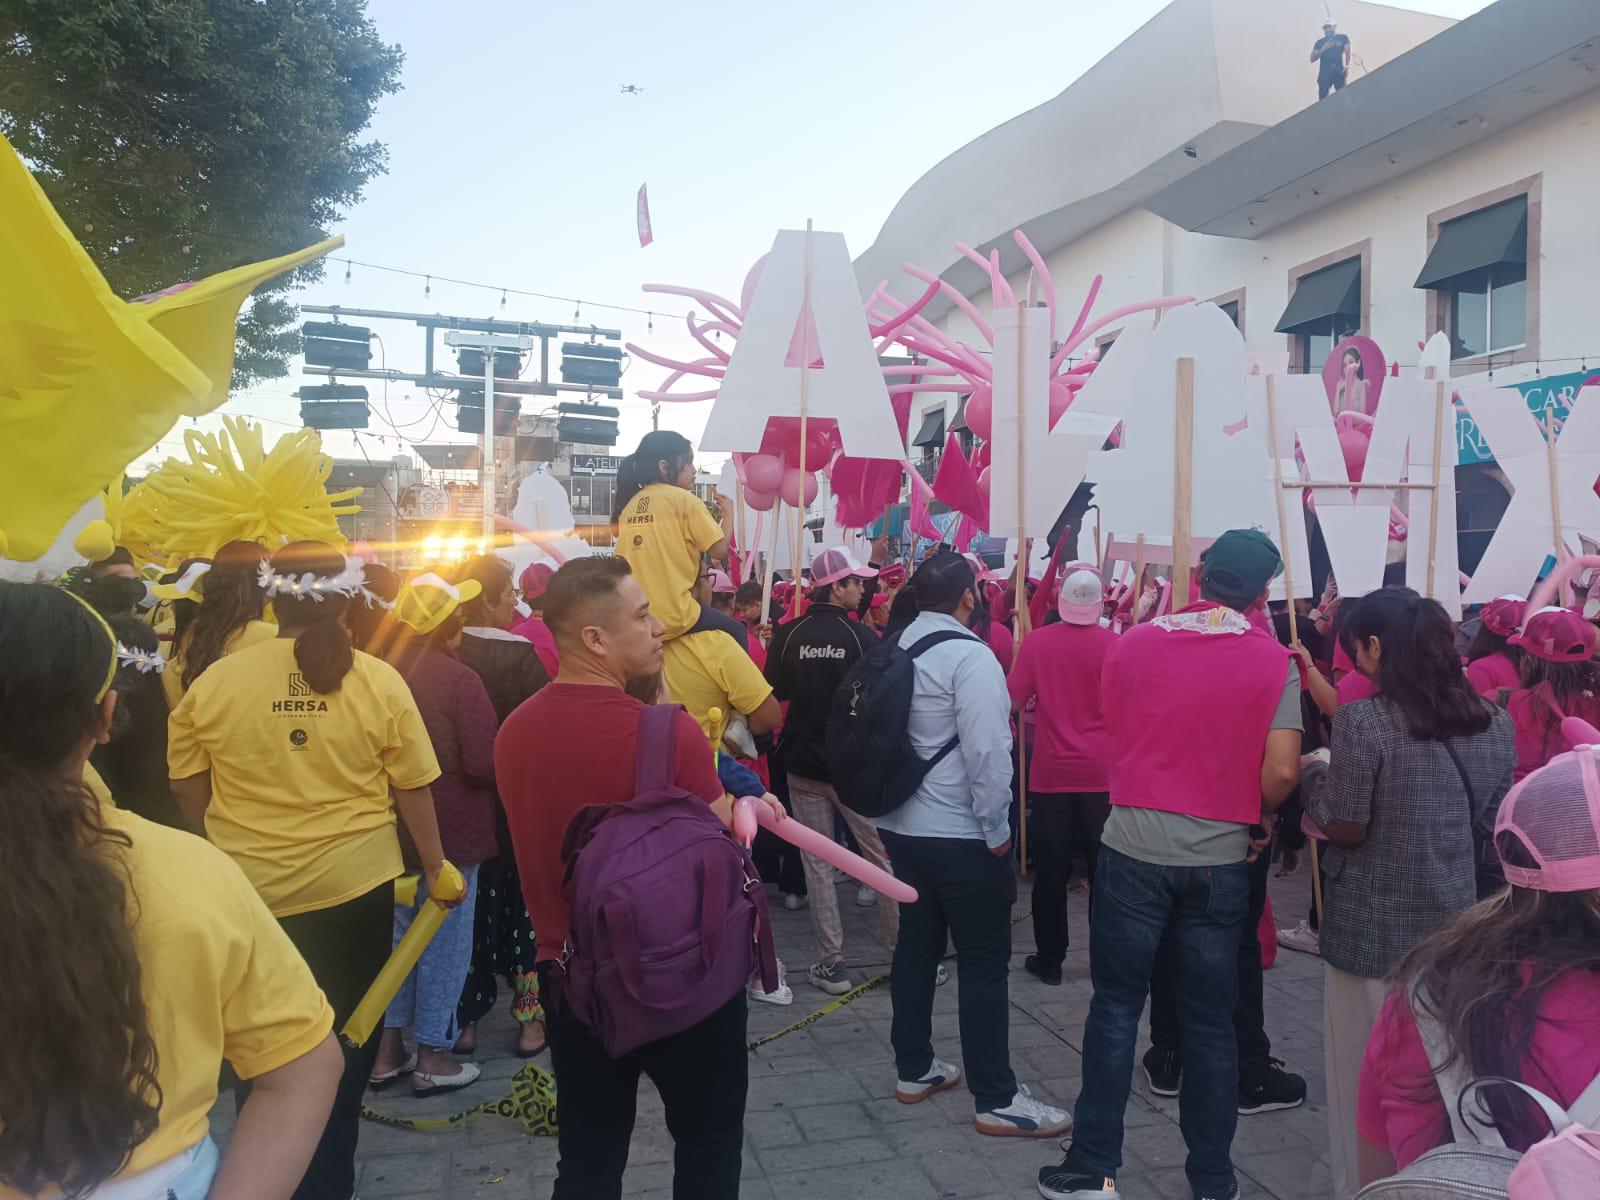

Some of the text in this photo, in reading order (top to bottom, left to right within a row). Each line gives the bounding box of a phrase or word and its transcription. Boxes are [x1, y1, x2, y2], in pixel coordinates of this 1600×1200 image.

[628, 515, 654, 525] HERSA
[799, 644, 846, 660] Keuka
[272, 700, 328, 713] HERSA
